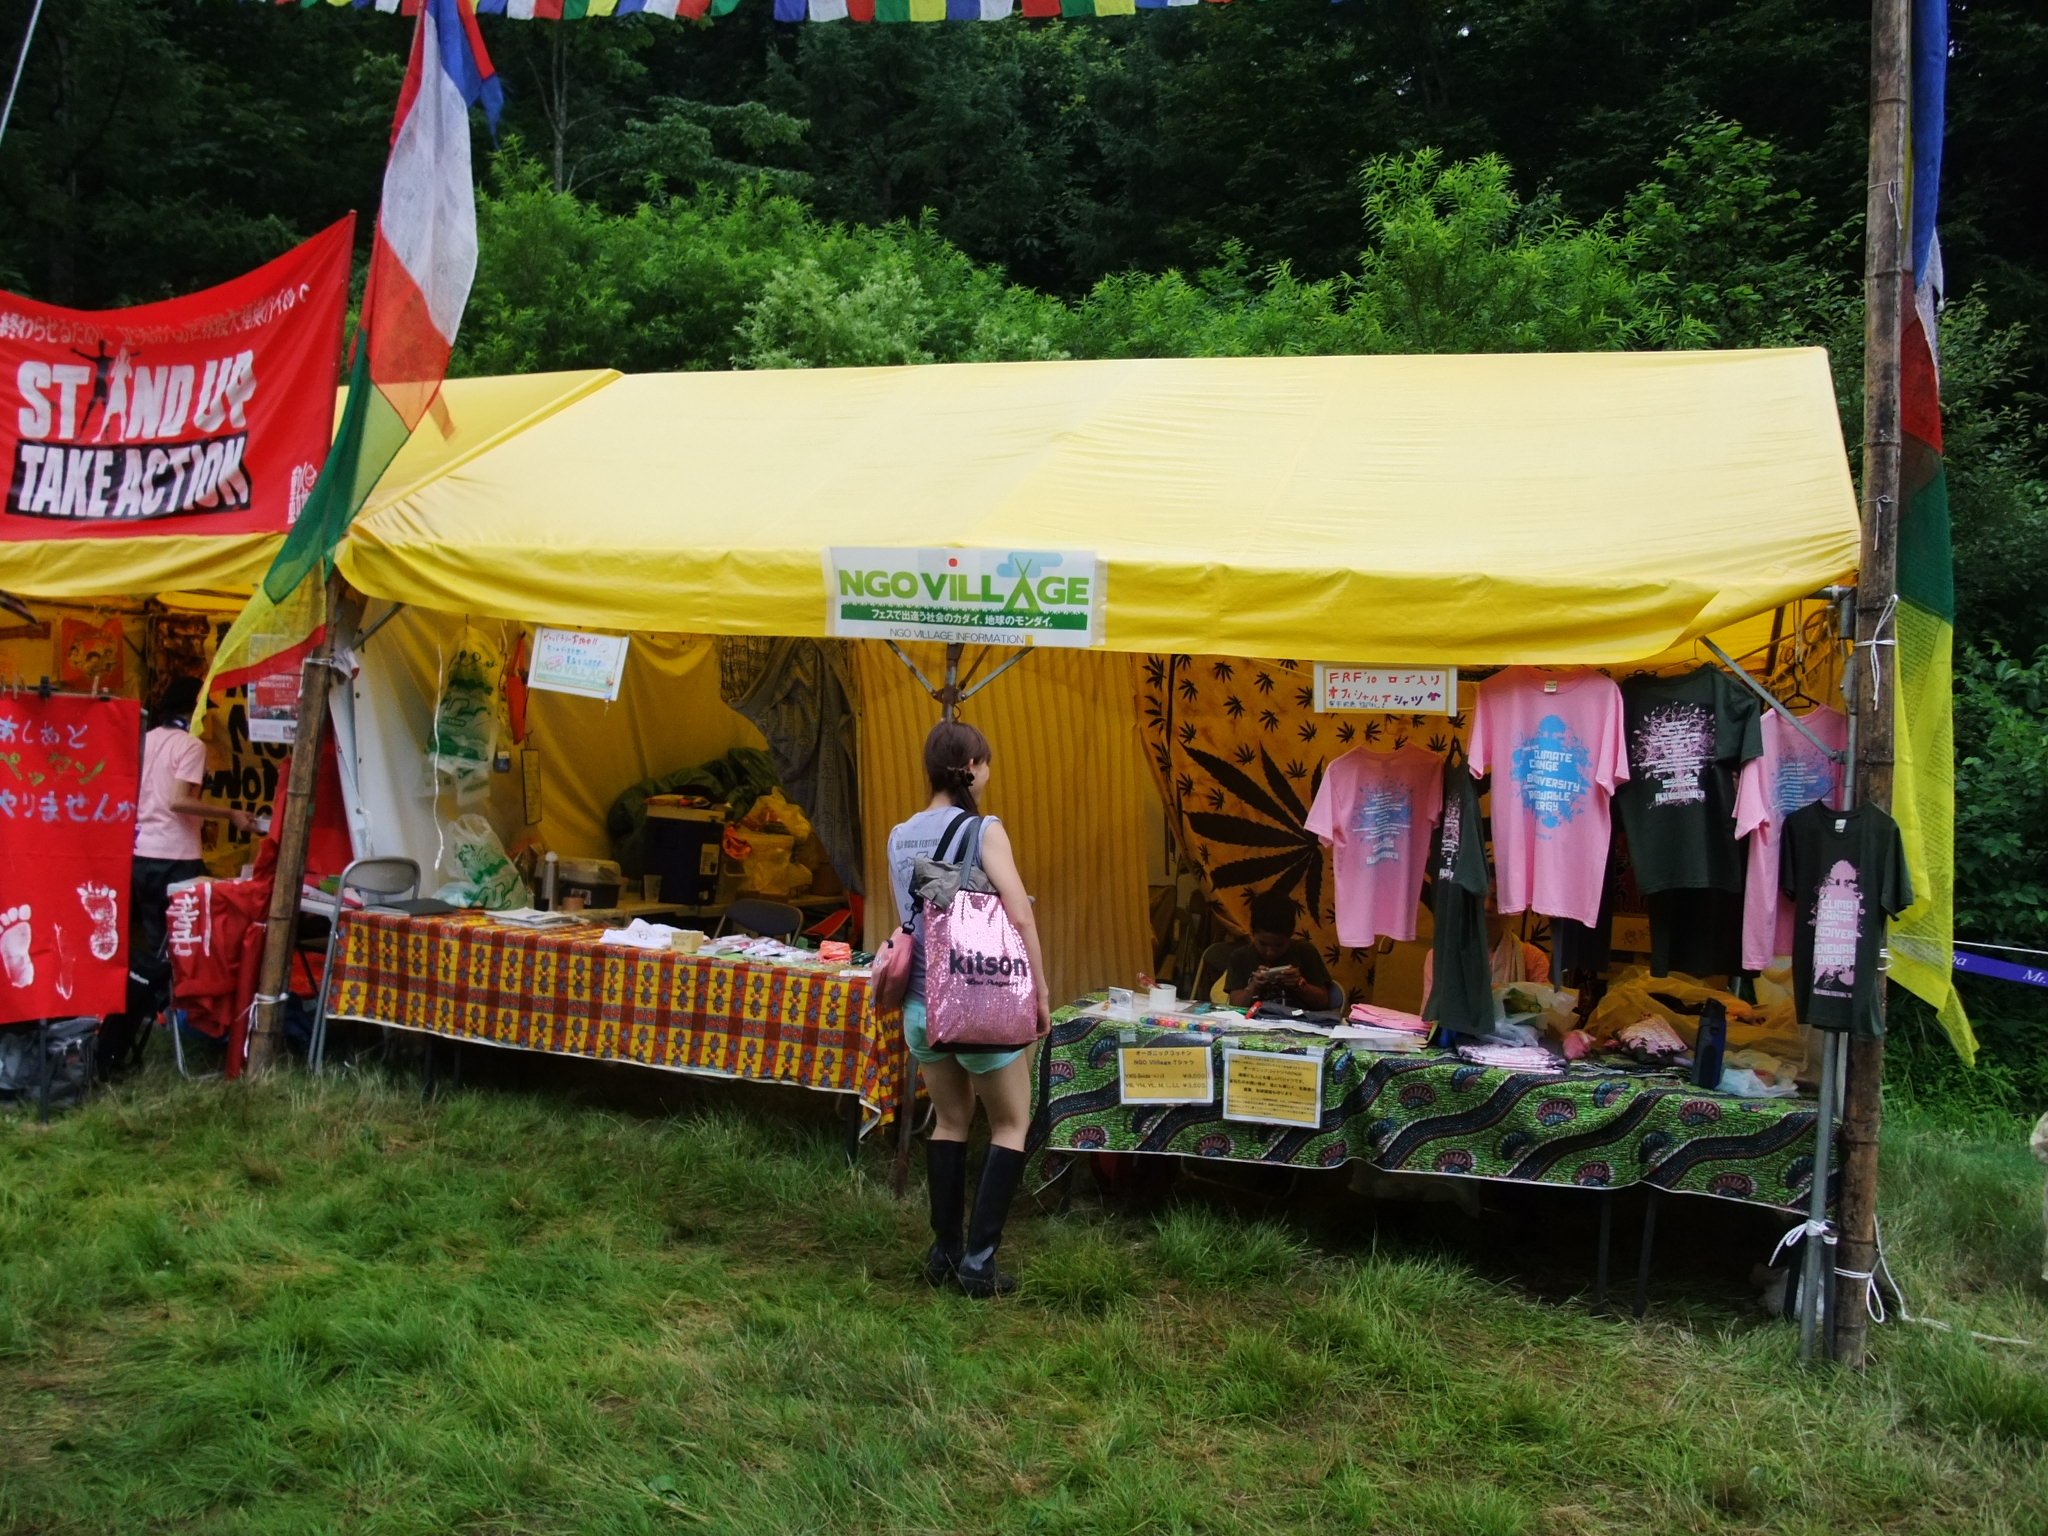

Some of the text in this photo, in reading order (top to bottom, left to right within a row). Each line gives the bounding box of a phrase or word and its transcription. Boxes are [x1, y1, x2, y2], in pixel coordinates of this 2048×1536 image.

[17, 349, 257, 443] STAND UP
[18, 446, 115, 517] TAKE
[110, 436, 250, 516] ACTION
[837, 556, 1088, 612] NGO VILLAGE
[890, 628, 1024, 645] NGO VILLAGE INFORMATION
[1821, 899, 1860, 910] CLIMAT
[949, 950, 1028, 978] kitson
[2022, 970, 2047, 984] Mt.
